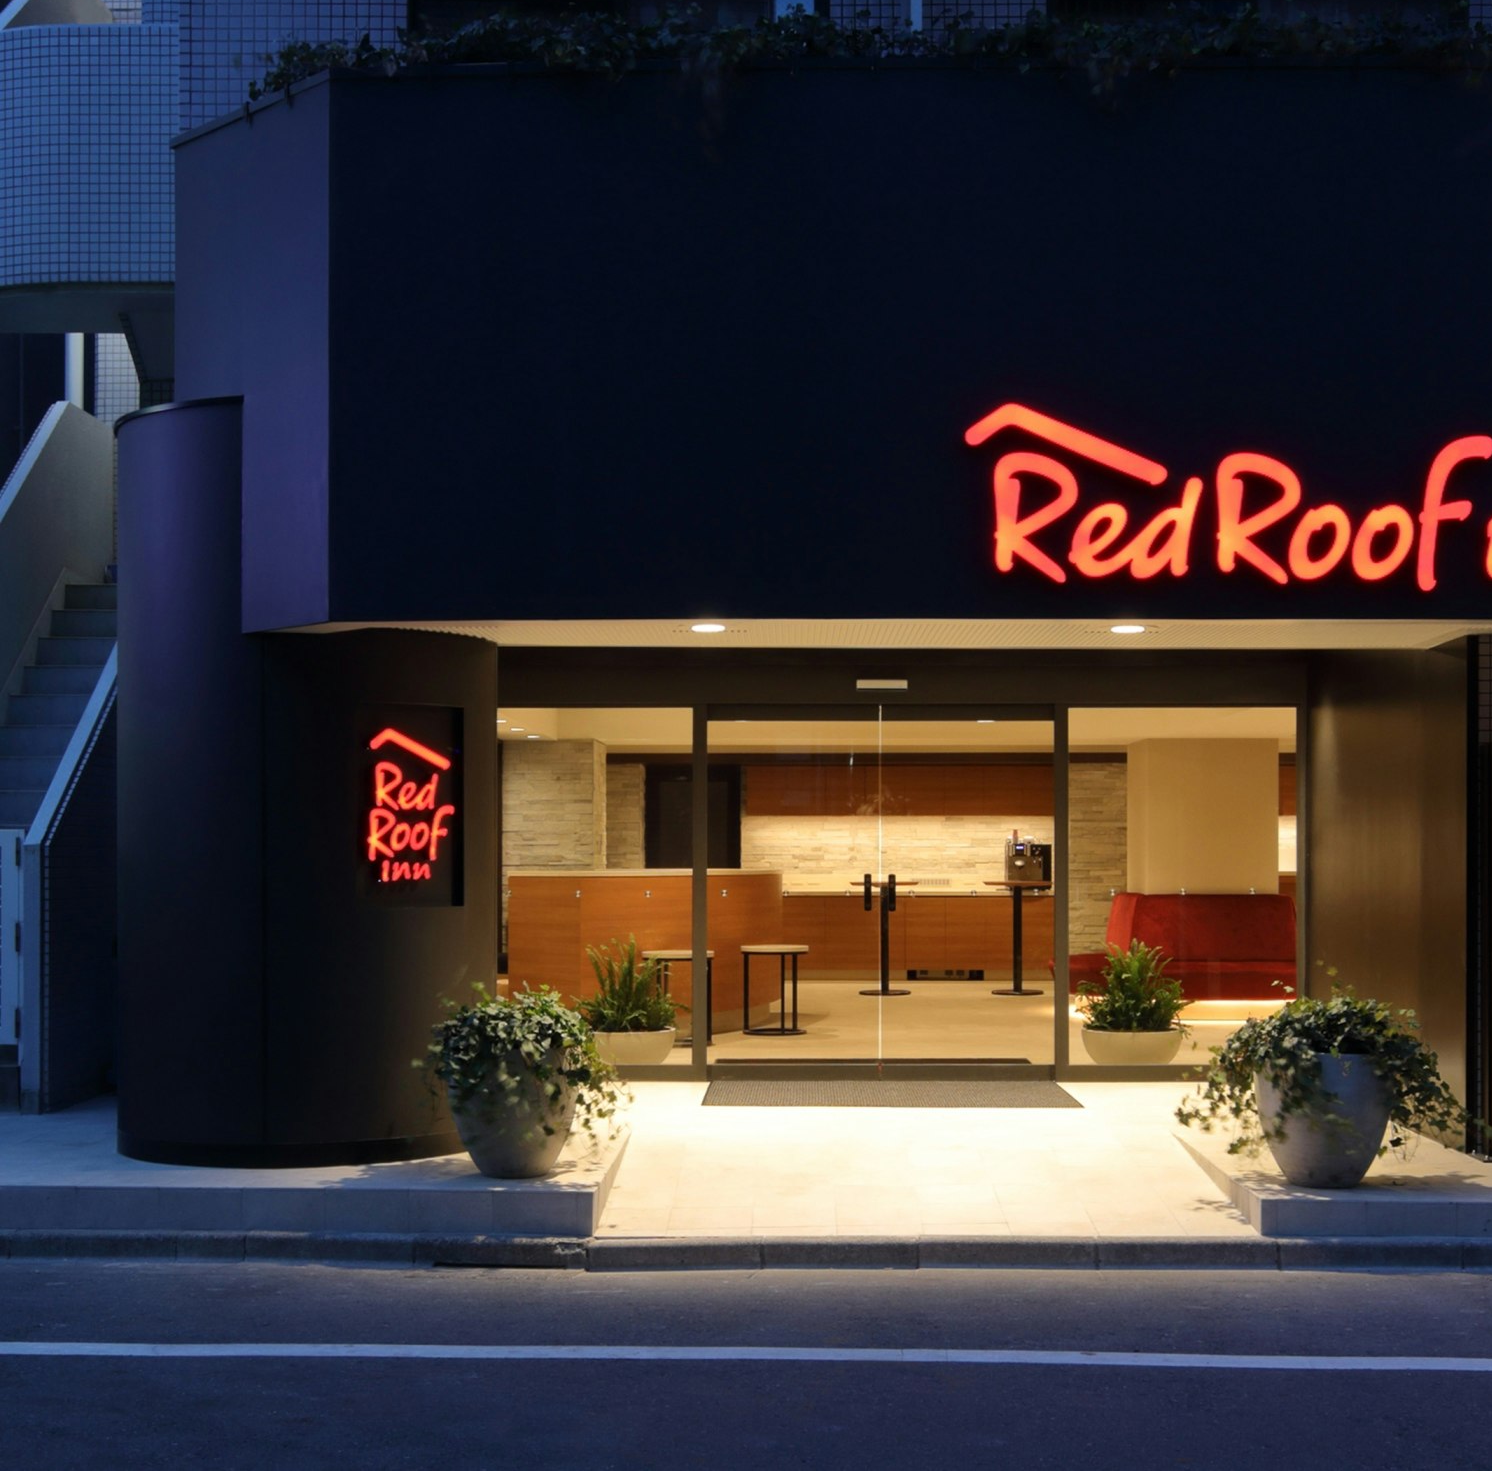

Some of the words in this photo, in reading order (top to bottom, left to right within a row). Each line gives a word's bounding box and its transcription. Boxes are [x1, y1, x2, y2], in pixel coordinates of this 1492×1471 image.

[994, 451, 1204, 583] Red
[375, 761, 439, 811] Red
[367, 805, 455, 861] Roof
